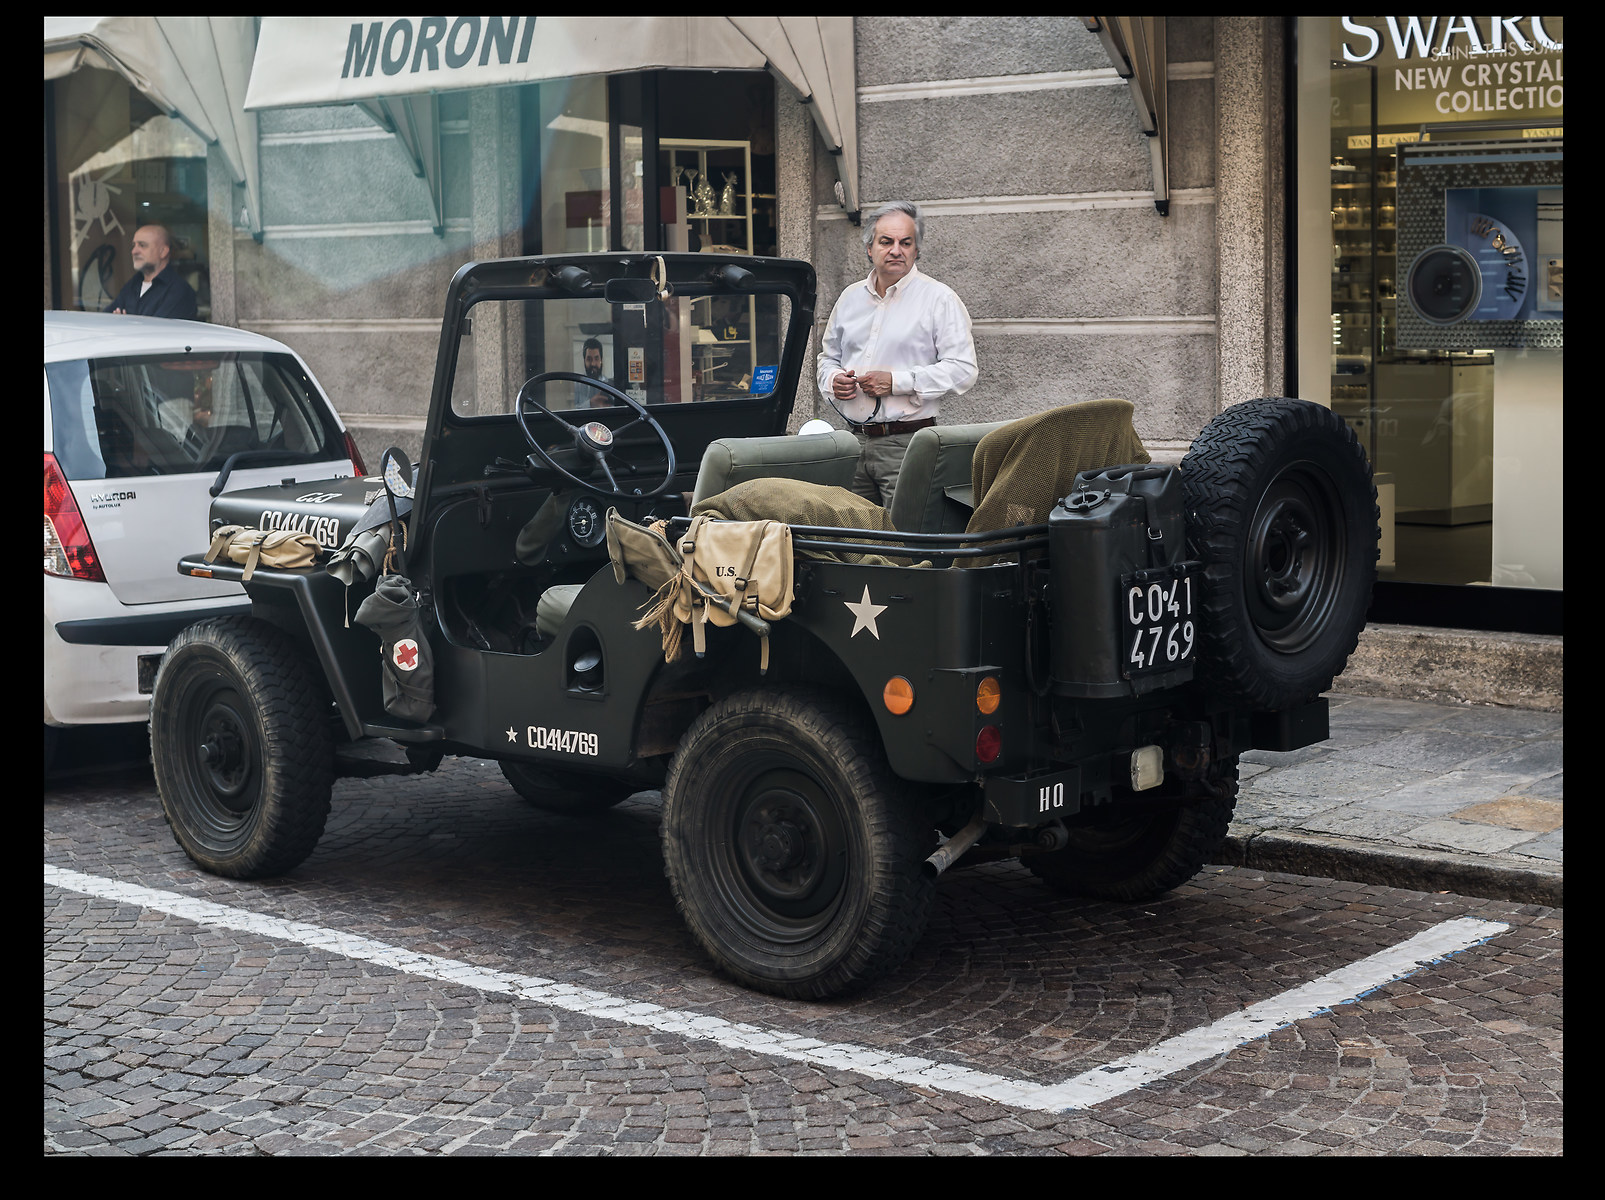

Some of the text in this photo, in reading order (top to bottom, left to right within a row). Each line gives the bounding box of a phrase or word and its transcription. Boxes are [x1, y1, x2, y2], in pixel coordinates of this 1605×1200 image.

[341, 17, 537, 79] MORONI
[1430, 39, 1564, 62] SHINE THIS SUM
[1395, 58, 1564, 91] NEW CRYSTAL
[1435, 84, 1564, 114] COLLECTIO
[295, 492, 343, 504] CJ3
[715, 566, 737, 577] U.S.
[1131, 620, 1194, 669] 4769
[1039, 782, 1064, 812] HQ
